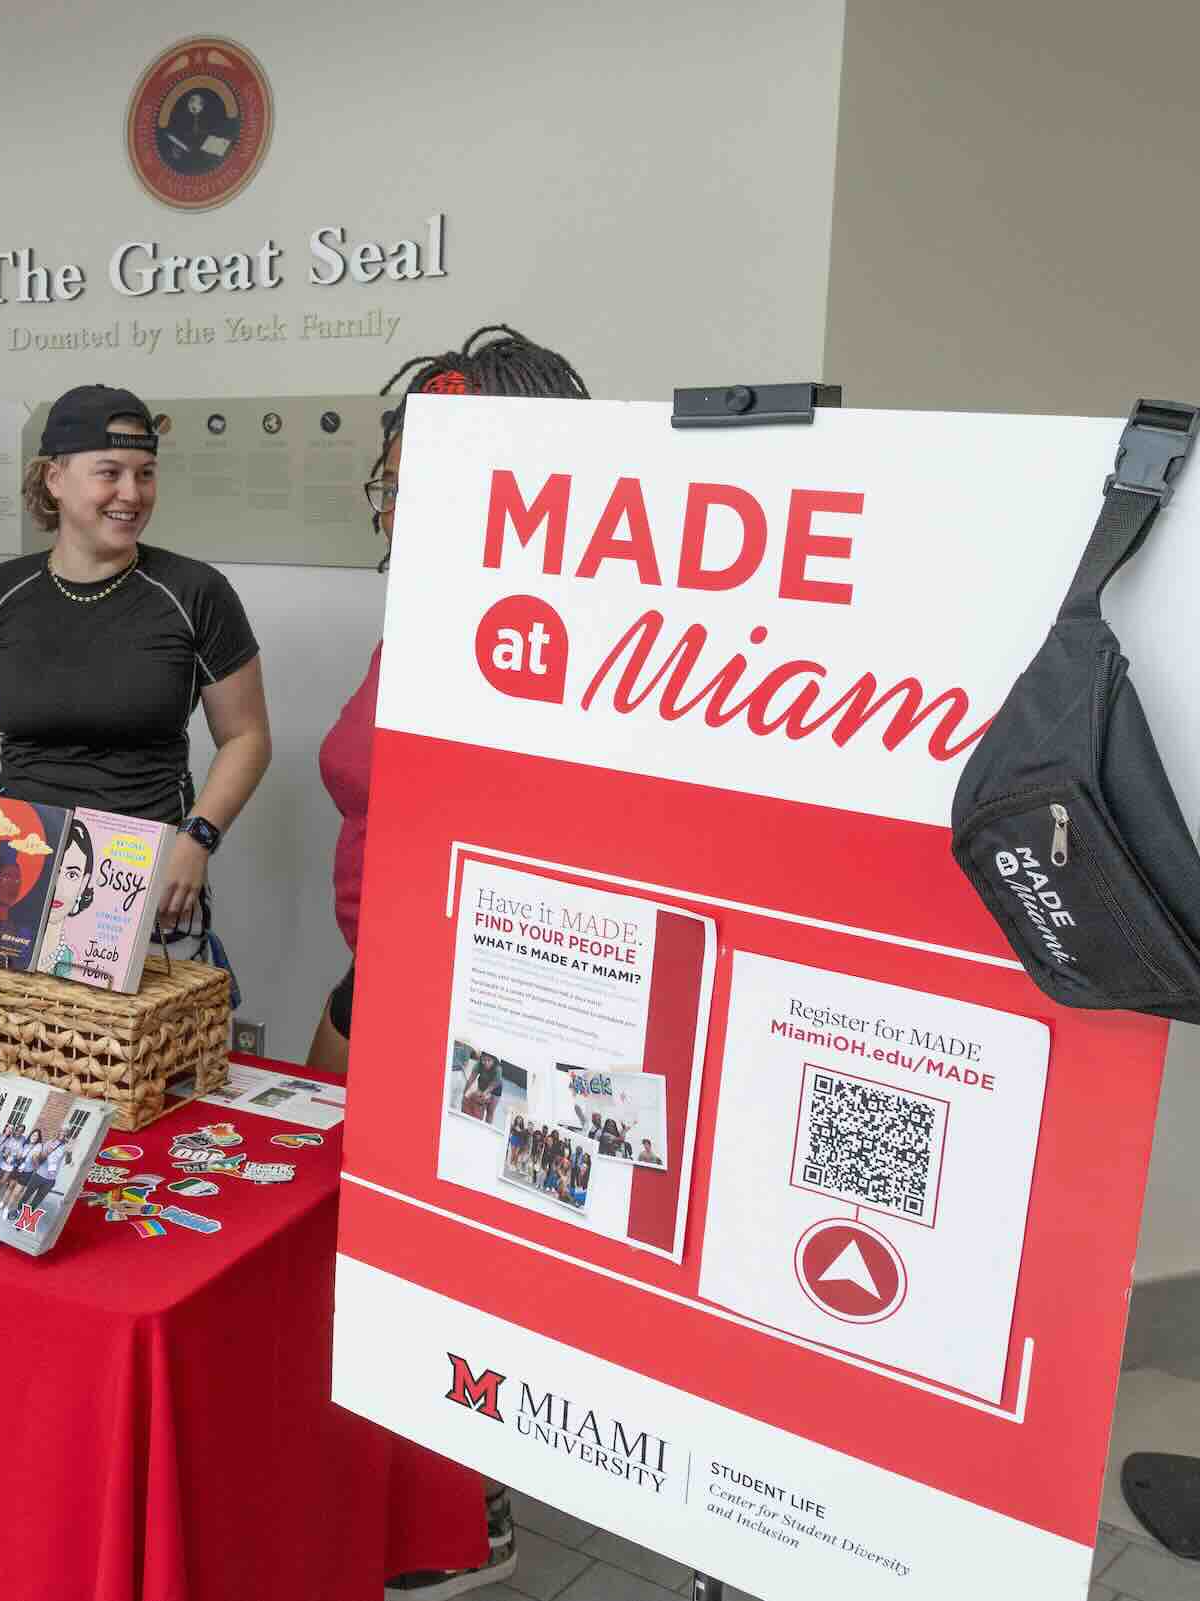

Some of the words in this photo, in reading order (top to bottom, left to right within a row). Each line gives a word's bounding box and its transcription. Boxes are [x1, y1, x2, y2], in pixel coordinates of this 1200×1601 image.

[108, 239, 285, 300] Great
[308, 212, 450, 286] Seal
[7, 321, 120, 354] Donated
[128, 319, 163, 356] by
[175, 316, 216, 345] the
[223, 313, 290, 344] Yeck
[300, 307, 401, 345] Family
[482, 468, 866, 606] MADE
[491, 620, 551, 676] at
[580, 608, 994, 763] Miam
[97, 858, 147, 912] Sissy
[475, 887, 533, 920] Have
[539, 902, 554, 926] it
[560, 907, 644, 947] MADE.
[1015, 847, 1078, 928] MADE
[84, 939, 120, 963] Jacob
[474, 911, 514, 934] FIND
[518, 922, 565, 947] YOUR
[568, 935, 637, 966] PEOPLE
[1002, 877, 1078, 965] Miami
[472, 933, 514, 954] WHAT
[515, 942, 529, 956] IS
[530, 945, 569, 968] MADE
[570, 958, 589, 973] AT
[591, 964, 642, 985] MIAMI?
[770, 1018, 997, 1092] MiamiOH.edu/MADE
[788, 998, 871, 1035] Register
[873, 1017, 905, 1043] for
[909, 1027, 983, 1064] MADE
[14, 1203, 46, 1233] M
[445, 1351, 507, 1424] M
[513, 1413, 668, 1496] UNIVERSITY
[516, 1379, 673, 1475] MIAMI
[710, 1461, 787, 1502] STUDENT
[790, 1493, 826, 1520] LIFE
[706, 1502, 733, 1521] and
[736, 1511, 801, 1550] Inclusion
[708, 1482, 757, 1509] Center
[754, 1503, 780, 1521] for
[782, 1513, 839, 1547] Student
[841, 1537, 912, 1578] Diversity
